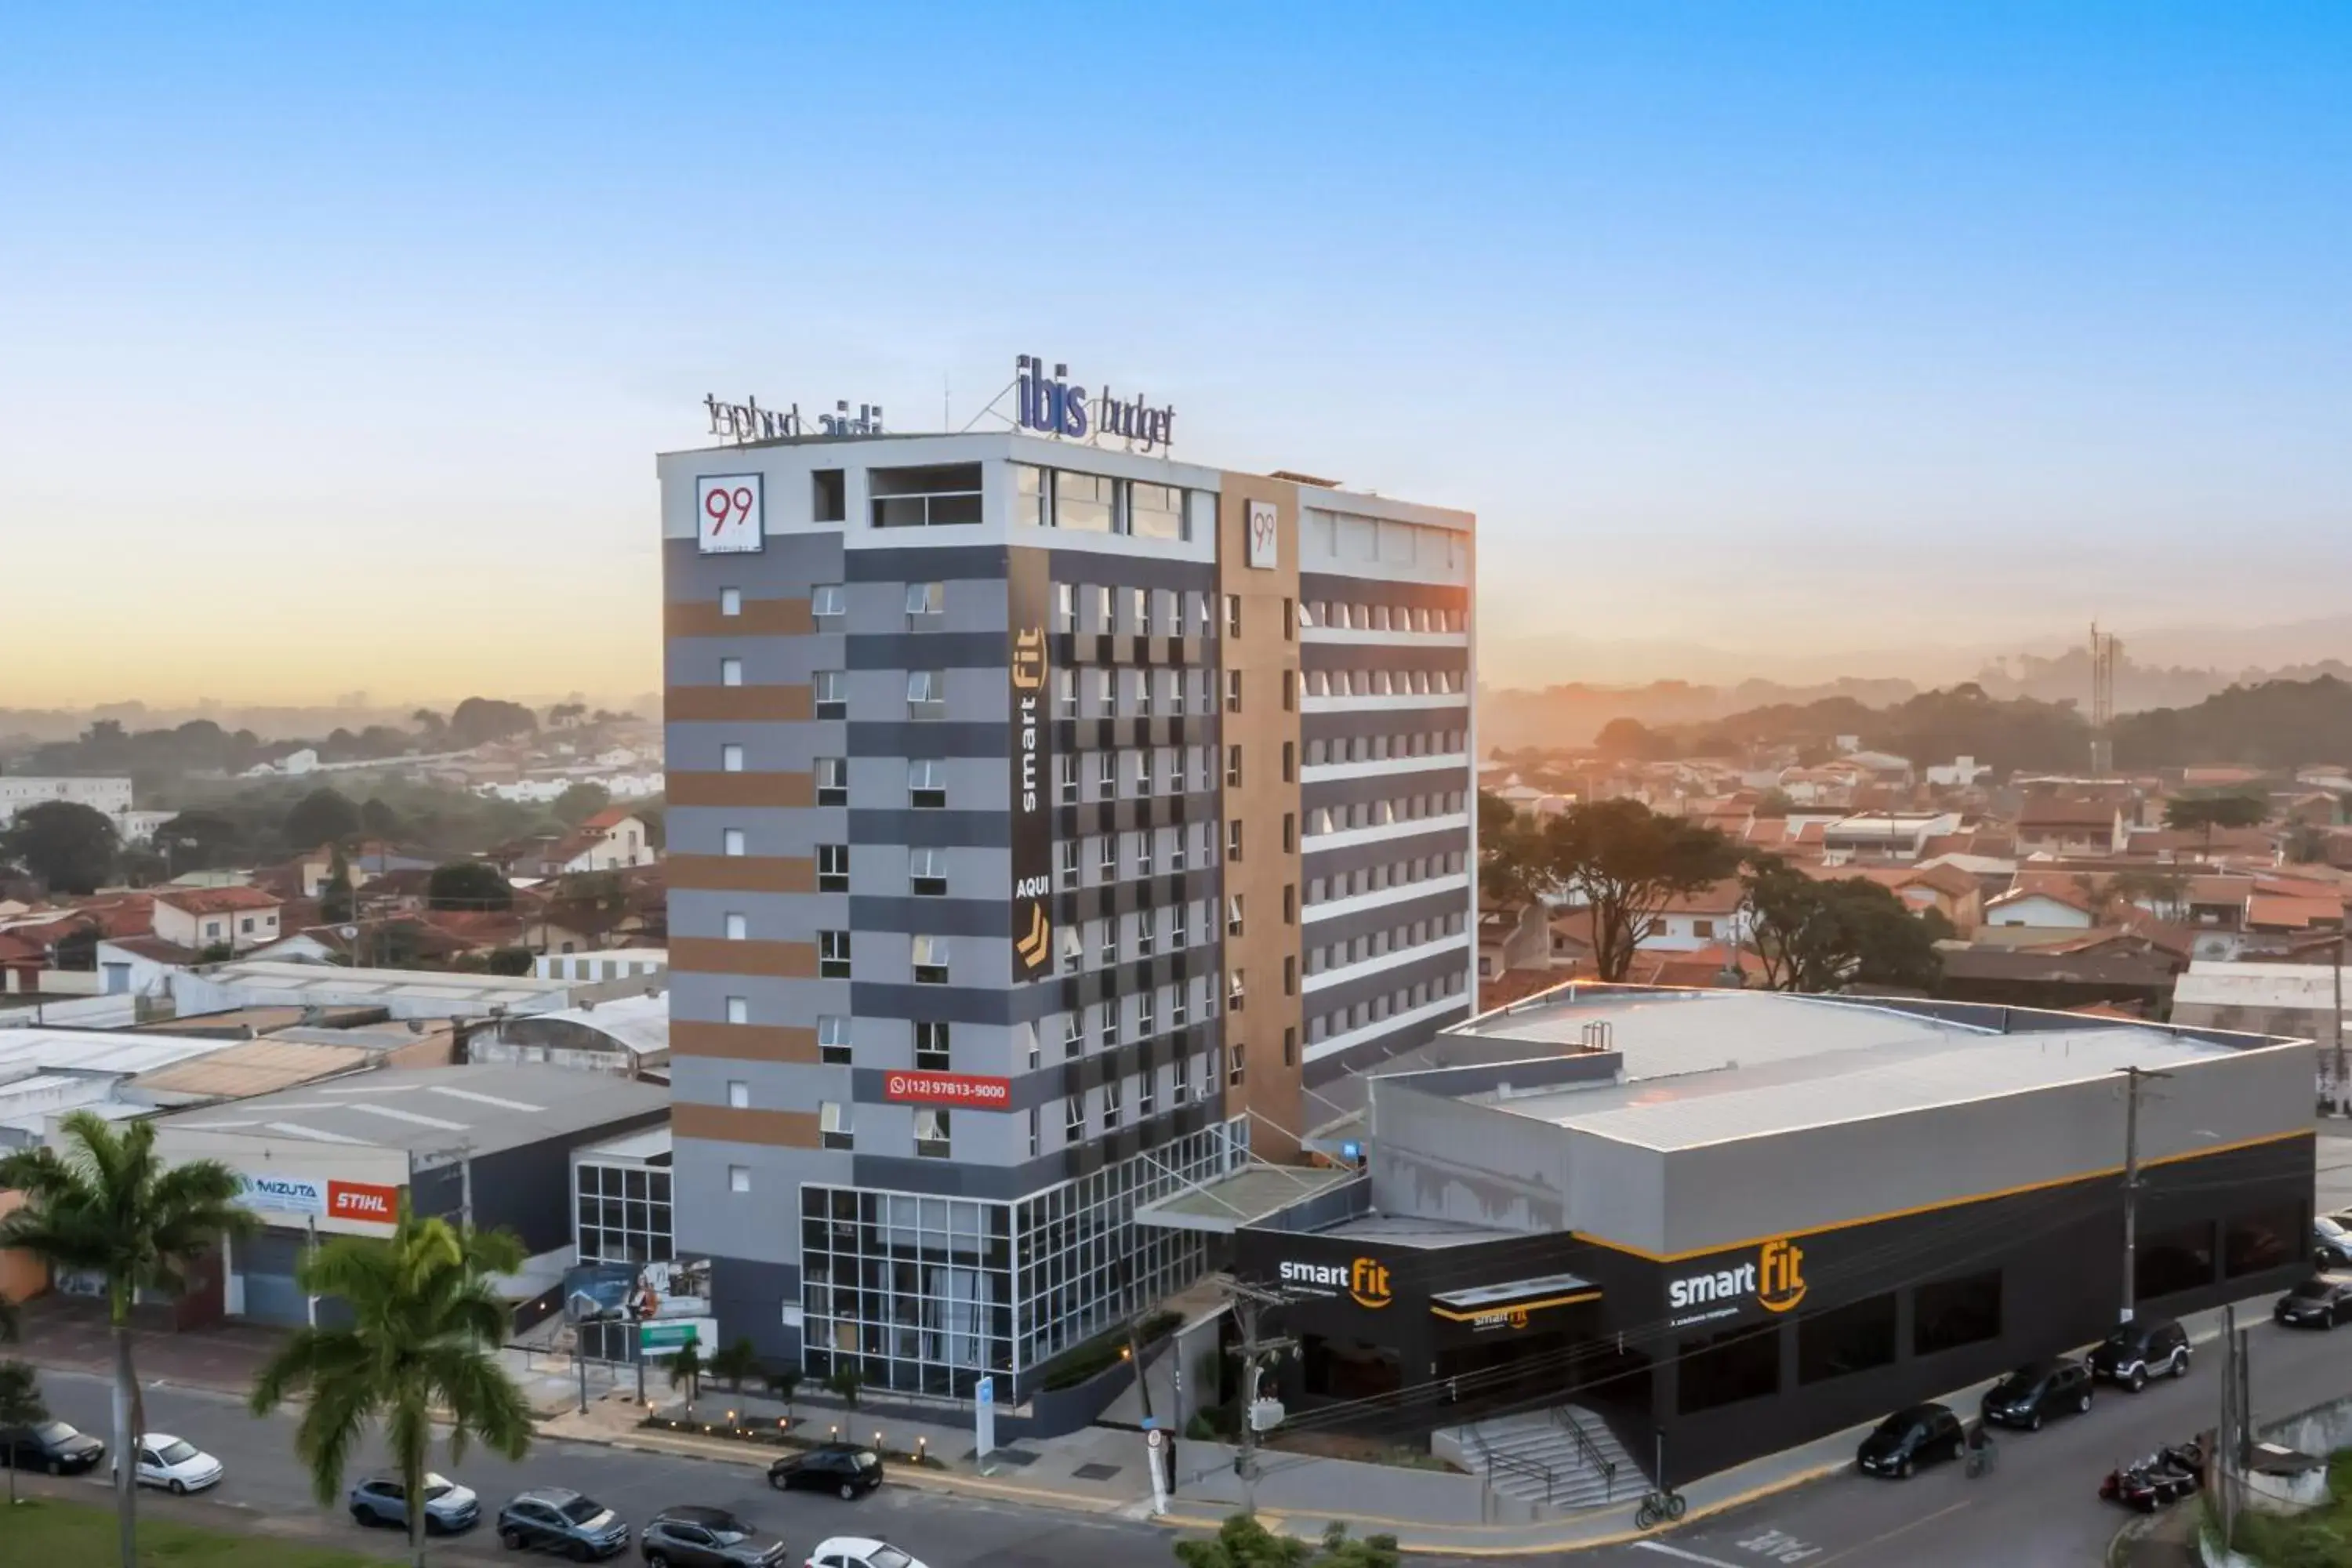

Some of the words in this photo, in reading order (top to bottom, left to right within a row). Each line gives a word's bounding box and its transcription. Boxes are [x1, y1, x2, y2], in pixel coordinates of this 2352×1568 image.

[1017, 354, 1087, 437] ibis
[1100, 385, 1176, 452] budget
[706, 488, 753, 535] 99
[1254, 512, 1275, 552] 99
[1013, 627, 1039, 688] fit
[1022, 697, 1036, 812] smart
[1016, 876, 1048, 898] AQUI
[256, 1179, 317, 1197] MIZUTA
[336, 1192, 387, 1212] STIHL
[1279, 1261, 1349, 1287] smart
[1352, 1257, 1390, 1297] fit
[1669, 1262, 1755, 1308] smart
[1761, 1240, 1805, 1295] fit
